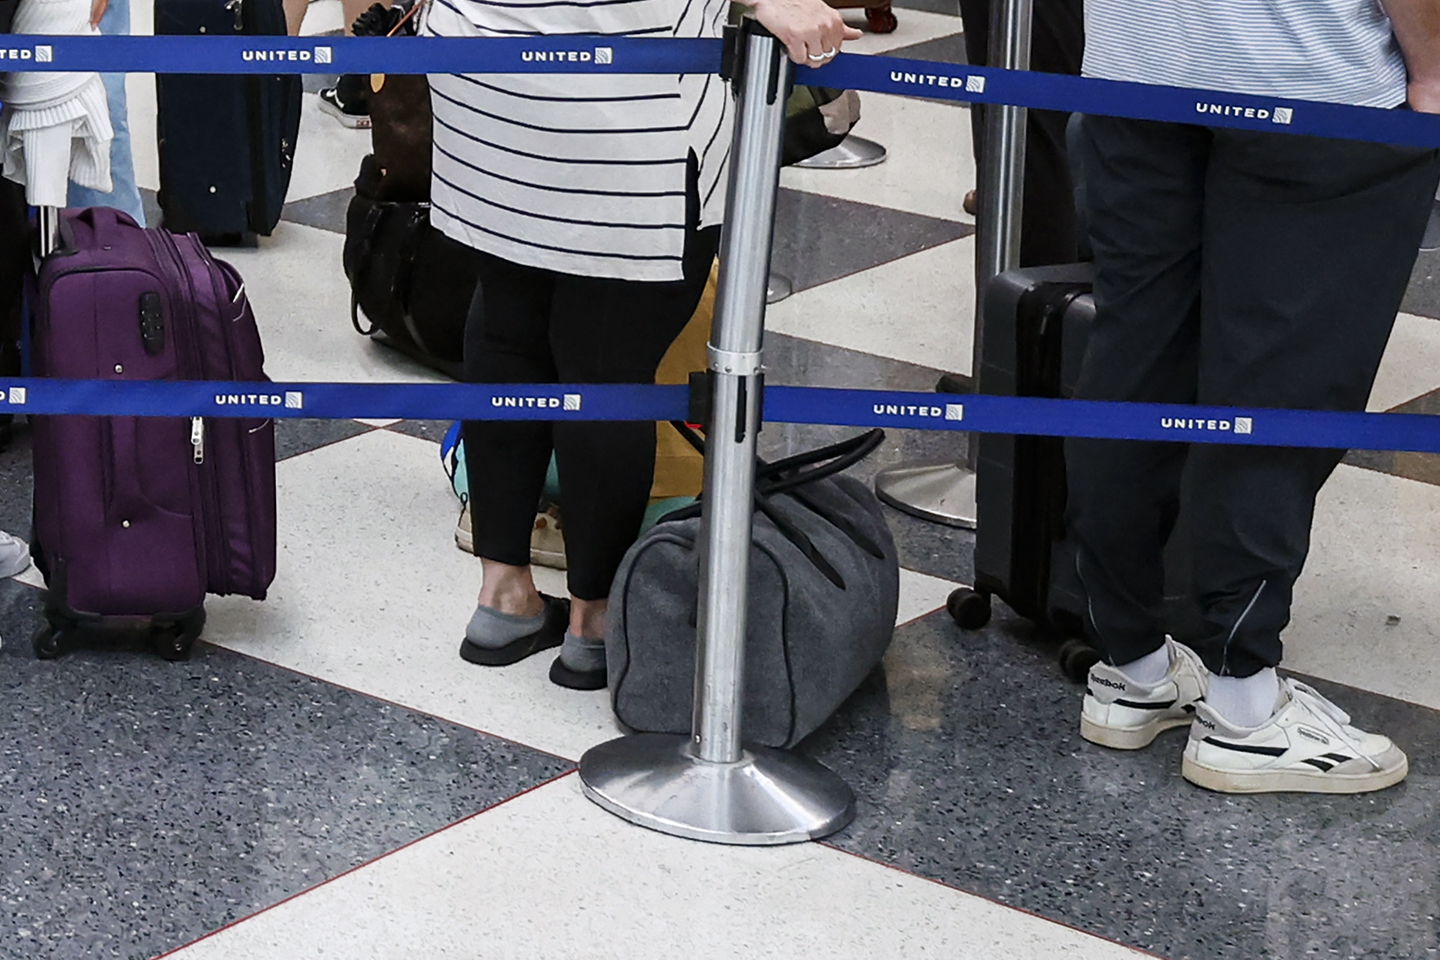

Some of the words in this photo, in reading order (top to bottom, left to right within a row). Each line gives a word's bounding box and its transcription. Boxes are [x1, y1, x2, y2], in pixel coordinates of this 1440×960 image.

[242, 50, 311, 61] UNITED
[521, 51, 592, 62] UNITED
[890, 71, 963, 88] UNITED
[1196, 102, 1270, 119] UNITED
[215, 394, 282, 405] UNITED
[491, 396, 560, 408] UNITED
[873, 404, 942, 417] UNITED
[1161, 418, 1231, 431] UNITED
